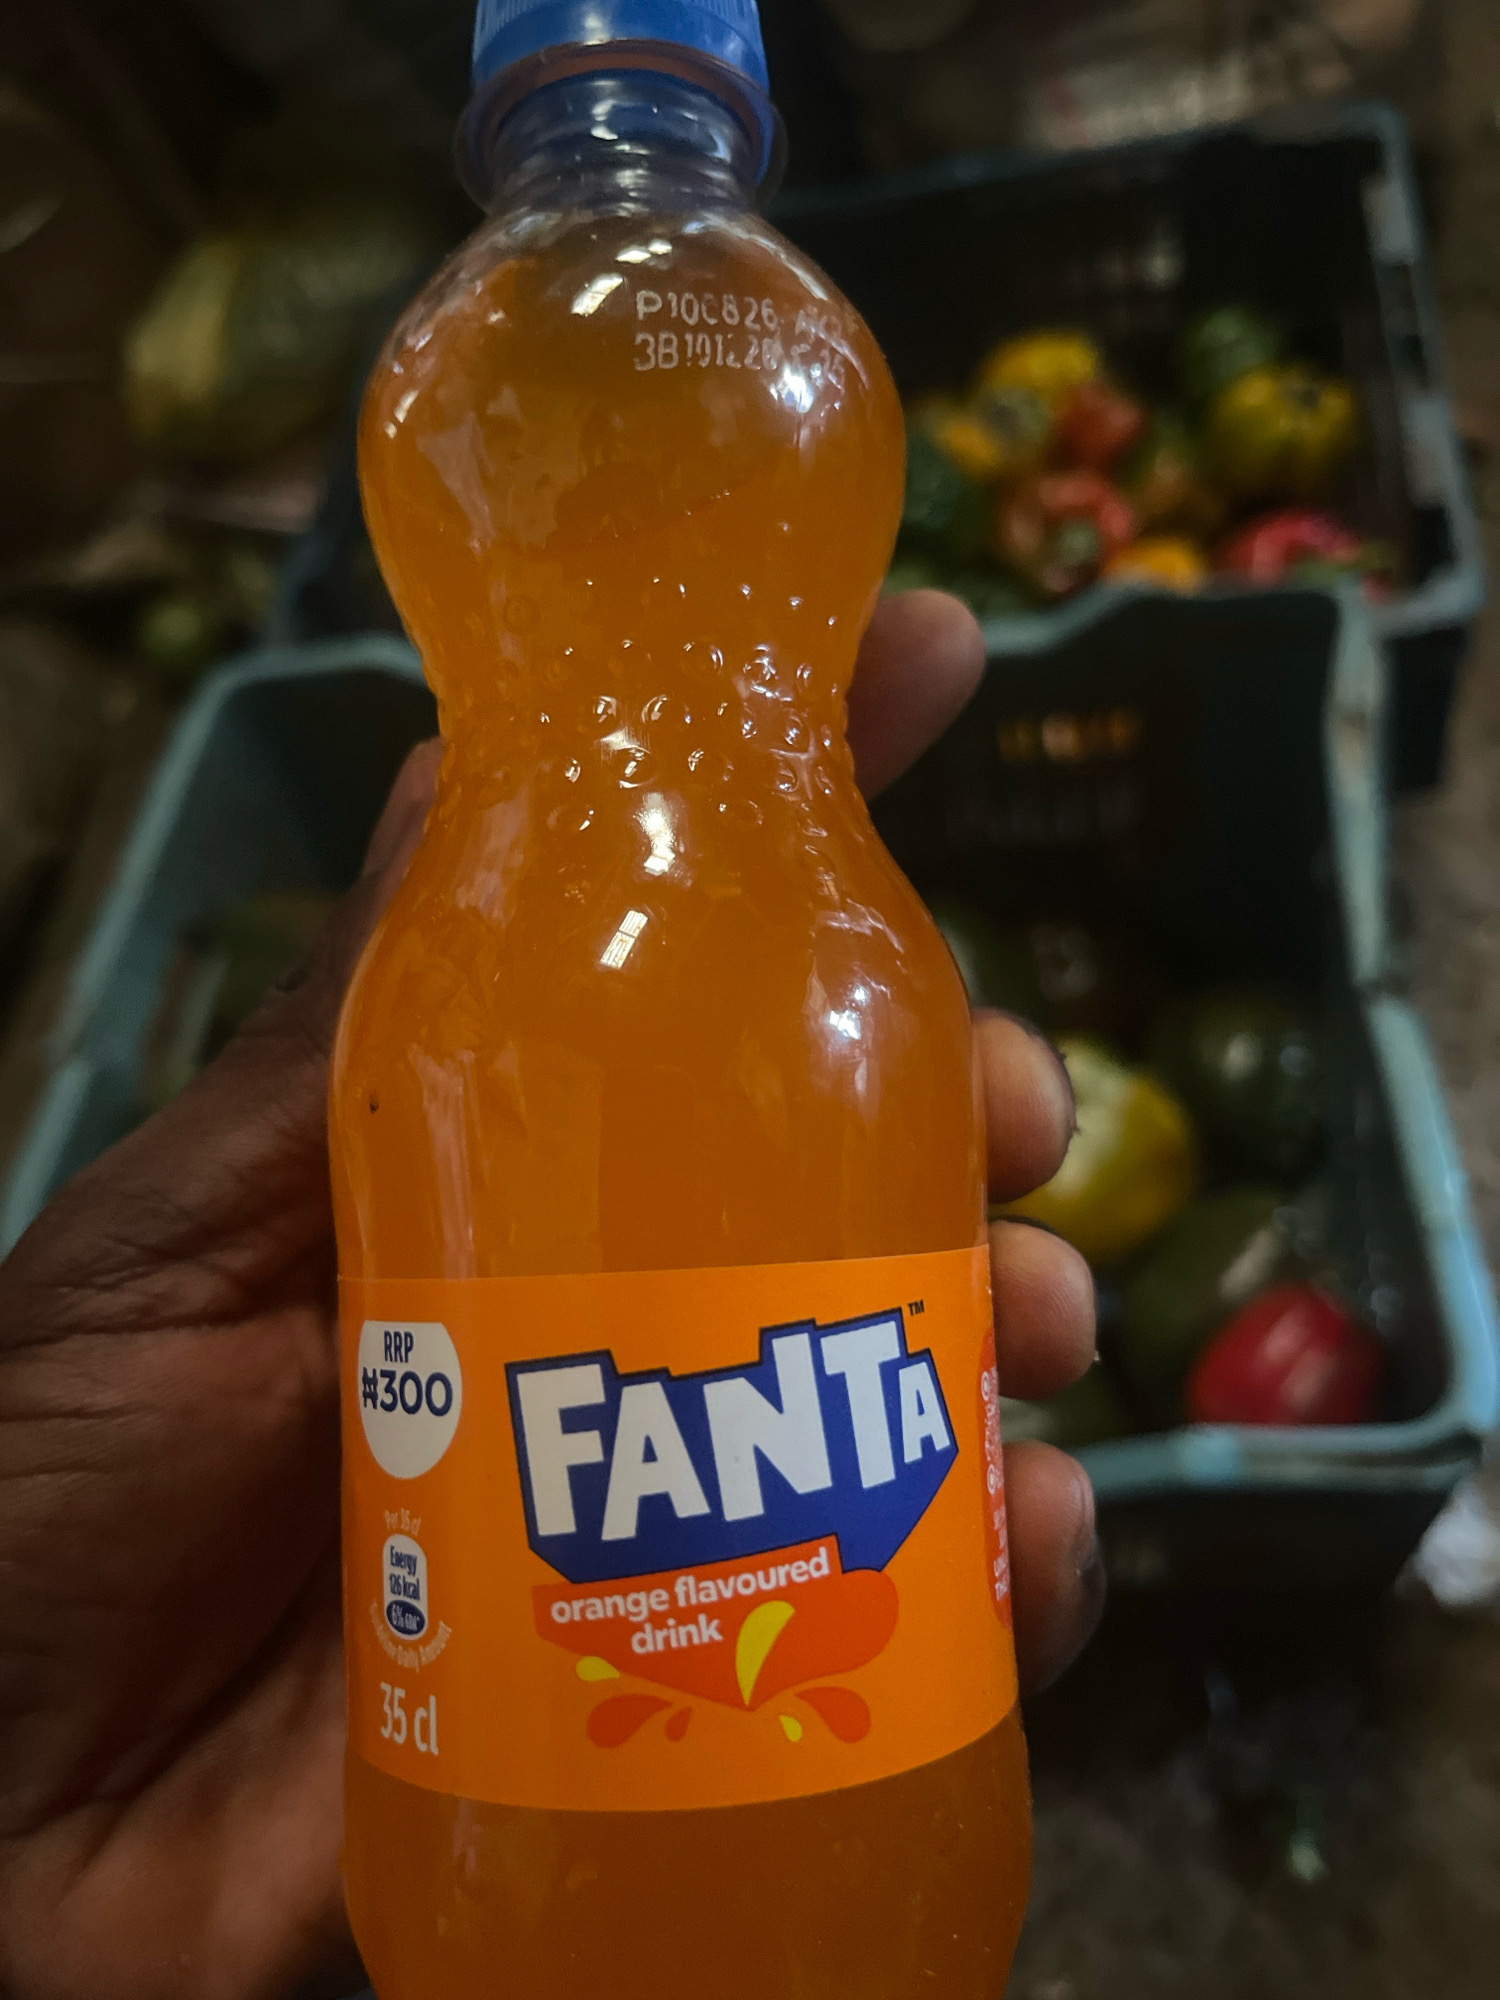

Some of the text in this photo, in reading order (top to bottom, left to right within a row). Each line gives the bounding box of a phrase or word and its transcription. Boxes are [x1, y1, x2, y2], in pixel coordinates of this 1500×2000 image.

[384, 1330, 414, 1363] RRP
[517, 1320, 950, 1541] FANTA
[390, 1545, 417, 1577] Energy
[402, 1575, 421, 1601] kcal
[550, 1547, 830, 1624] orange flavoured
[631, 1613, 723, 1655] drink
[380, 1681, 439, 1756] 35 cl
